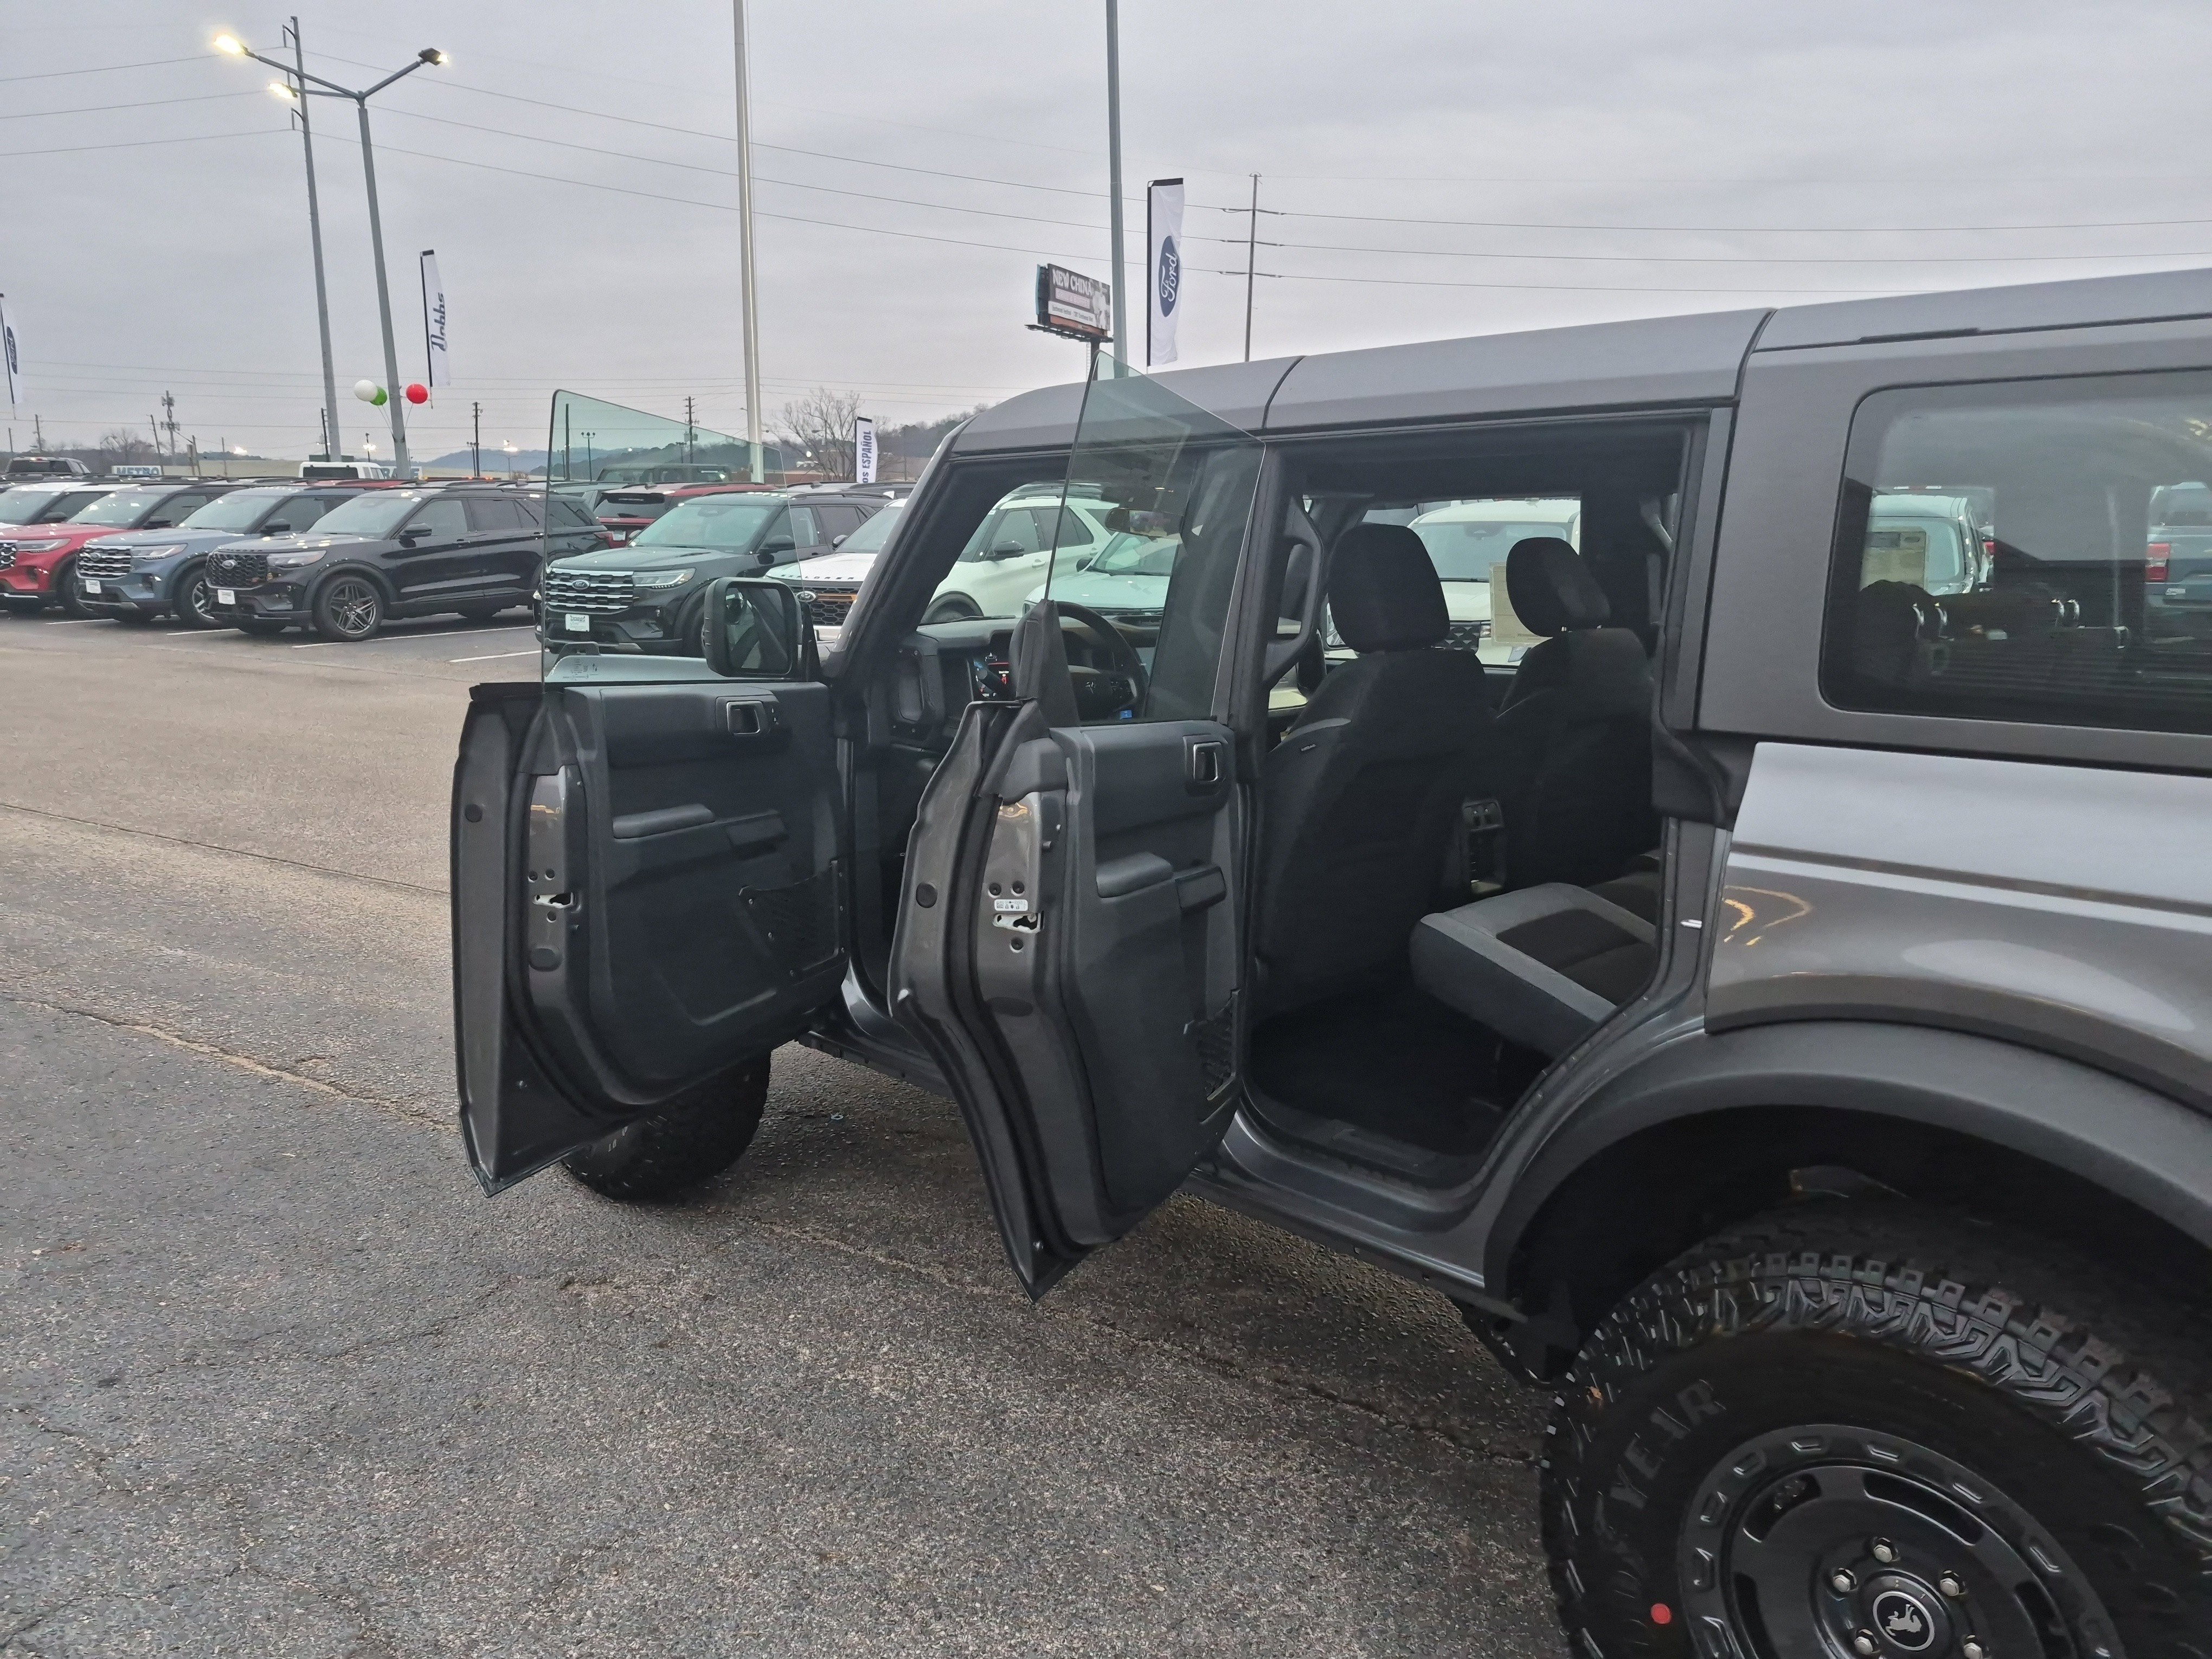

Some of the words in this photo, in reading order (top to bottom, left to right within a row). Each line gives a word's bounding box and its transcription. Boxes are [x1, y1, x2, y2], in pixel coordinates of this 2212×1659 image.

[1052, 268, 1069, 290] NEW
[1070, 275, 1092, 297] CHINA
[1161, 253, 1177, 302] Ford
[861, 430, 872, 469] ESPAÑOL
[117, 467, 159, 475] METRO
